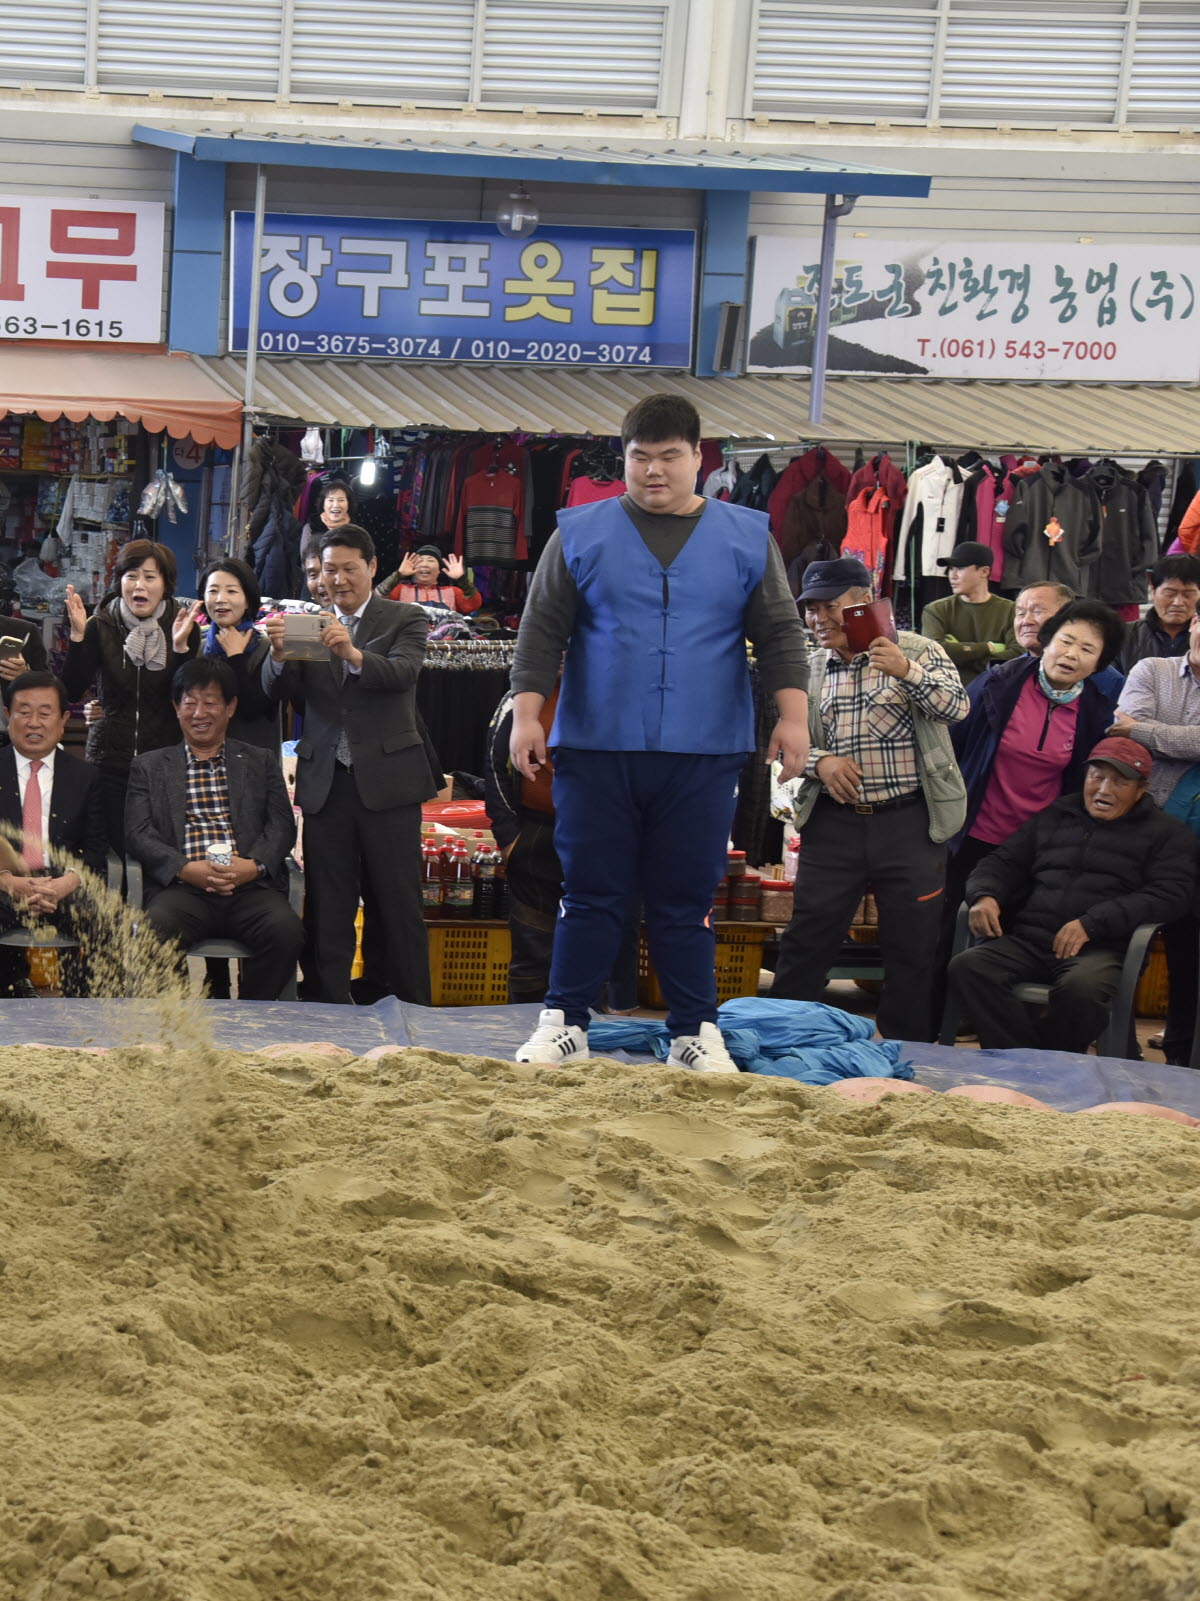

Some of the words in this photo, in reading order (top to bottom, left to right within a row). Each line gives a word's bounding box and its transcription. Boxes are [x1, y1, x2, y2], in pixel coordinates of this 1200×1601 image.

[260, 332, 441, 357] 010-3675-3074
[471, 339, 652, 363] 010-2020-3074
[917, 338, 996, 360] T.(061)
[1004, 340, 1117, 361] 543-7000
